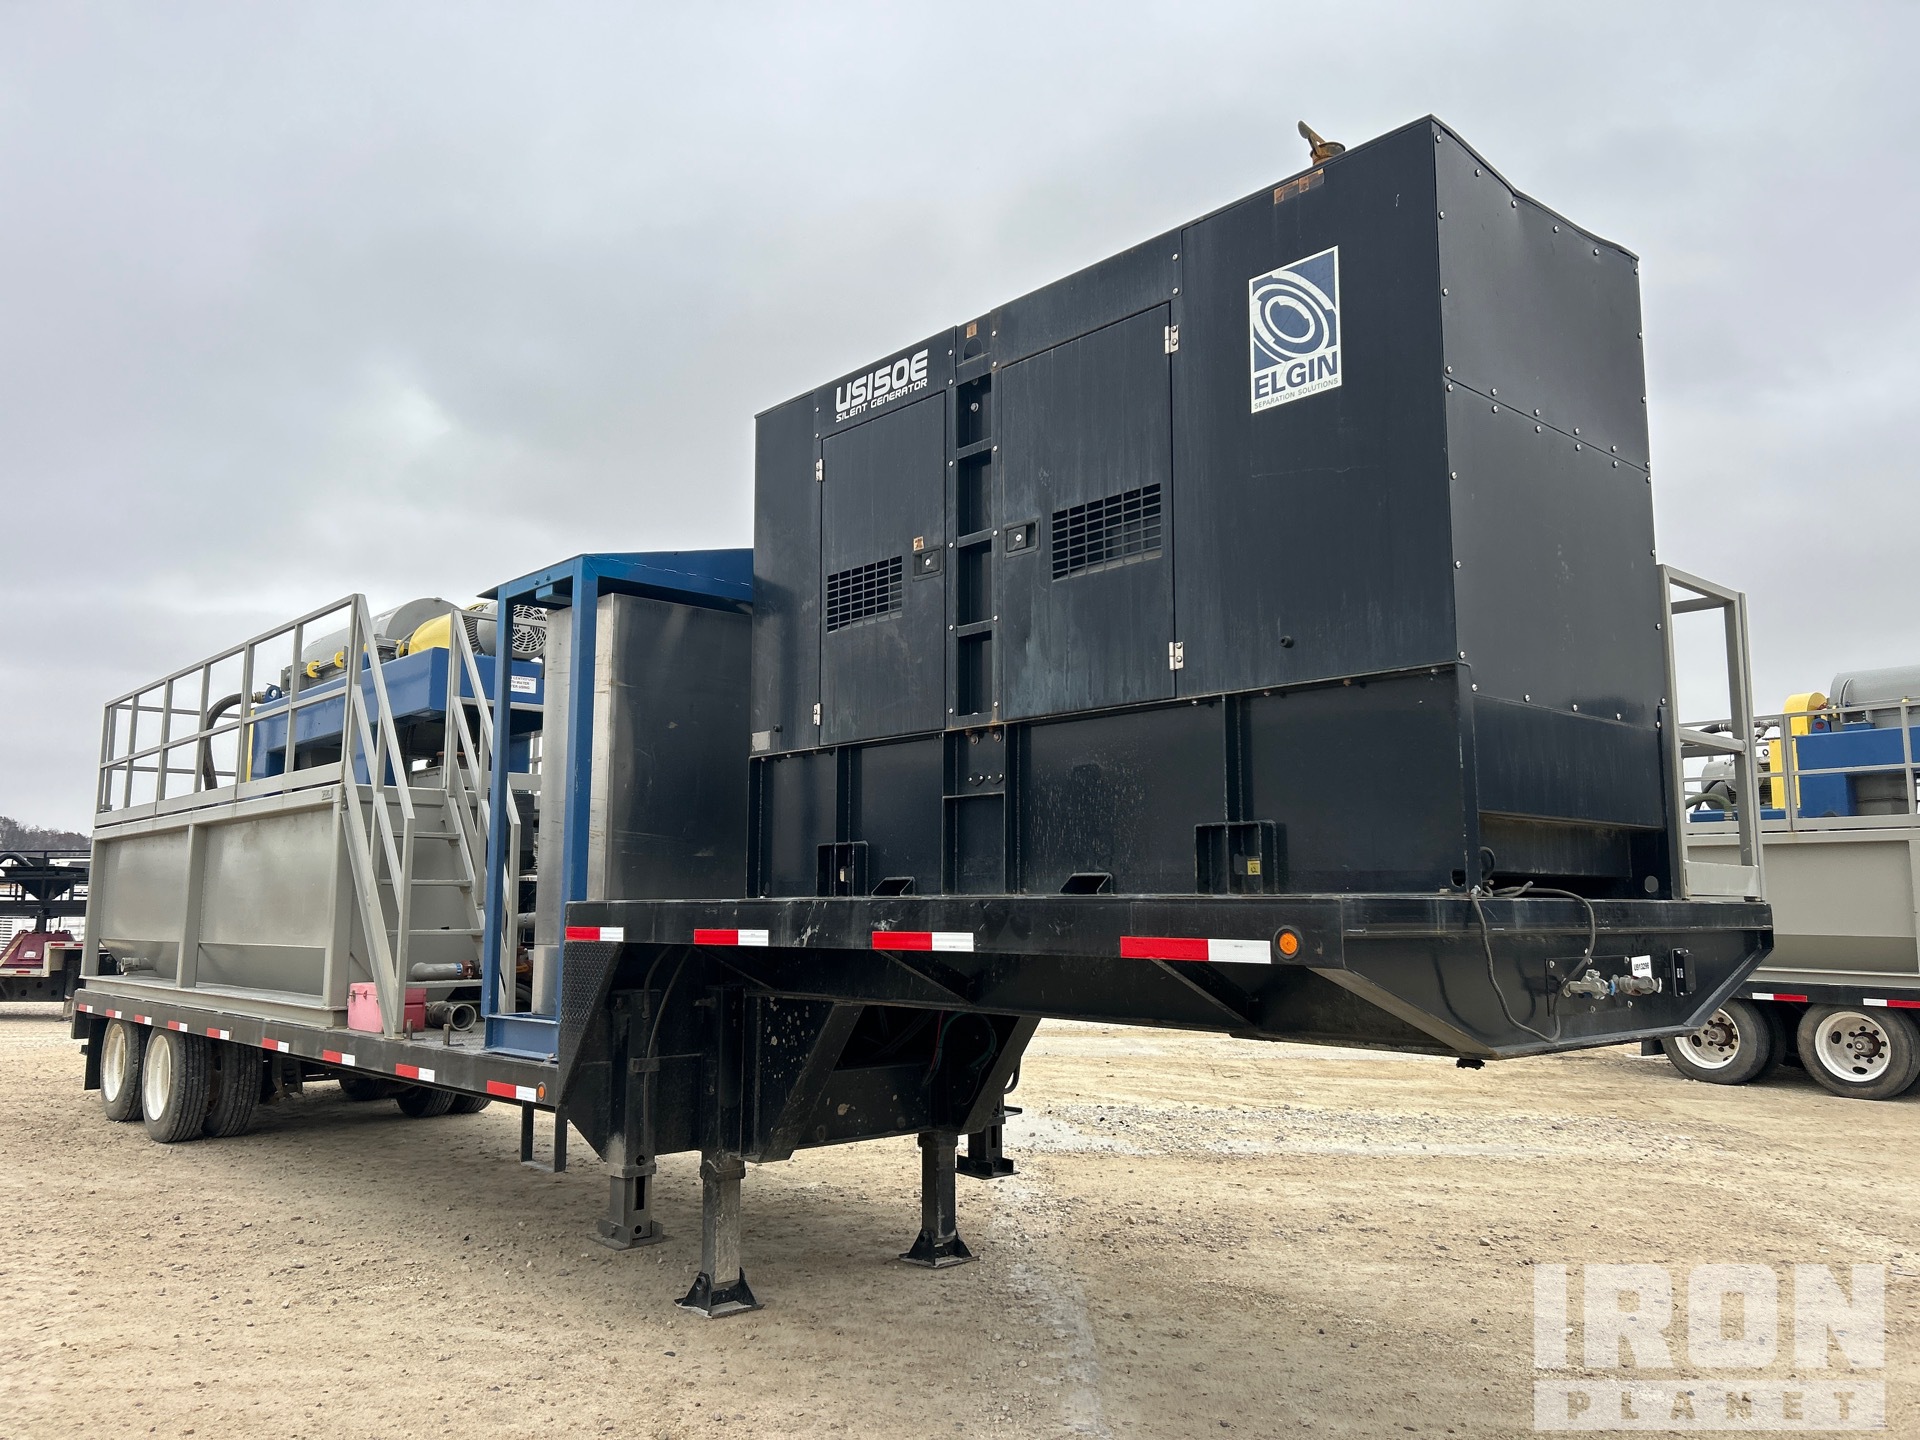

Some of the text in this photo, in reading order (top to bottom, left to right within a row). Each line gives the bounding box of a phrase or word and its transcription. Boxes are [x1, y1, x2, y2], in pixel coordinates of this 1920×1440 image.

[1254, 350, 1338, 401] ELGIN
[1254, 377, 1339, 410] SEPARATION SOLUTIONS
[835, 377, 928, 423] SILENT GENERATOR
